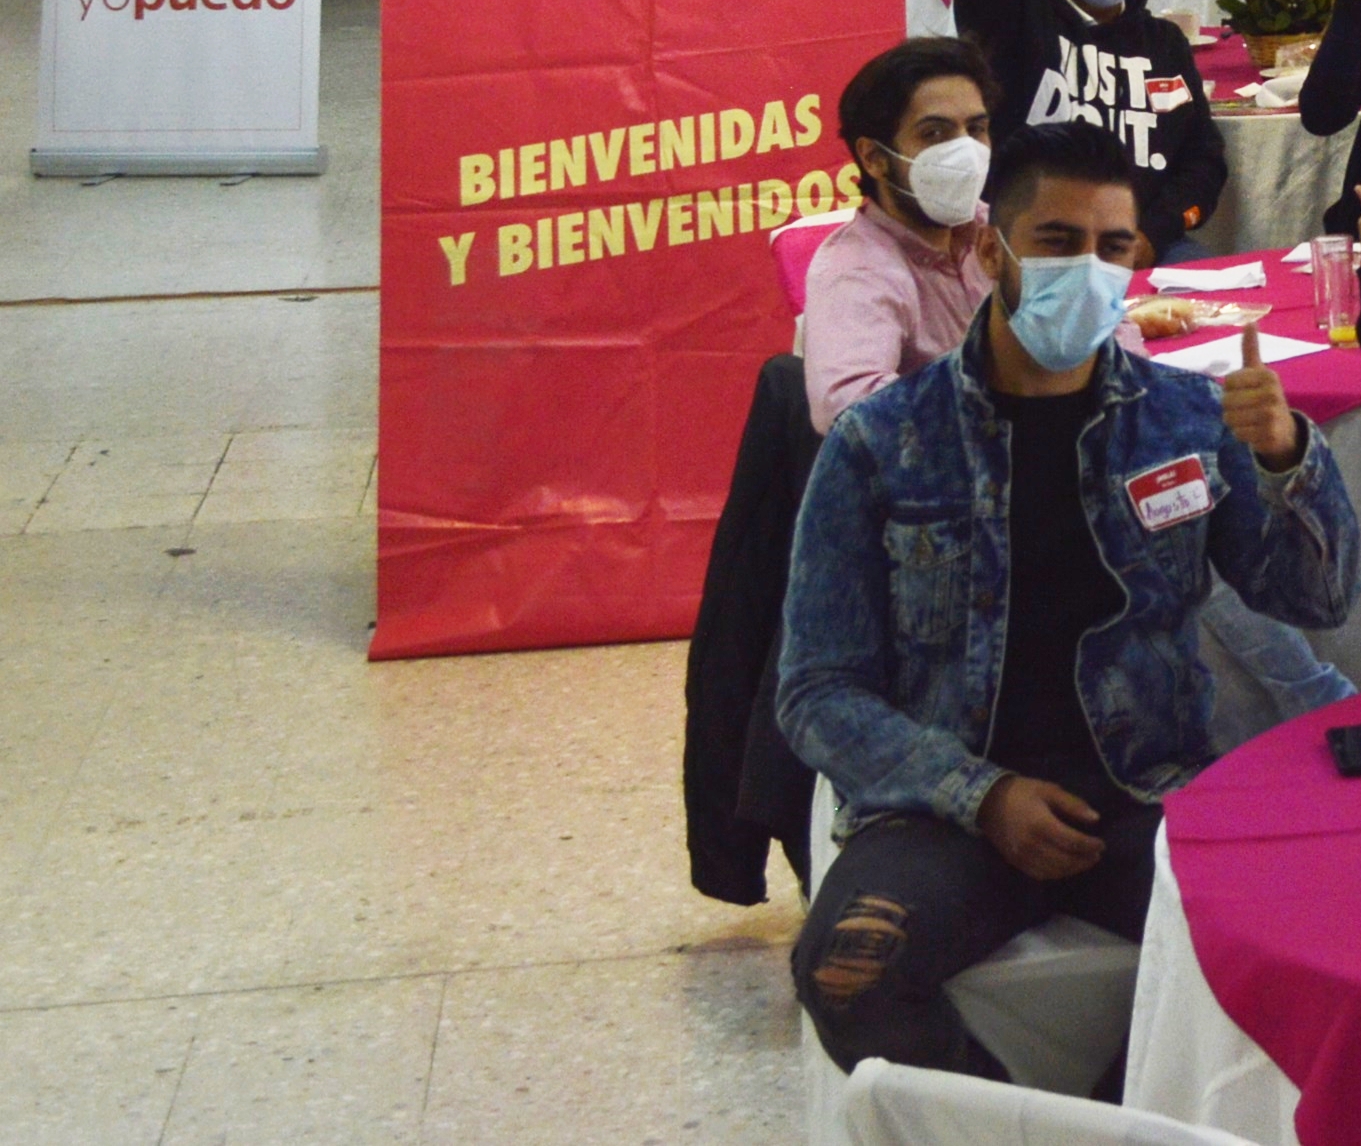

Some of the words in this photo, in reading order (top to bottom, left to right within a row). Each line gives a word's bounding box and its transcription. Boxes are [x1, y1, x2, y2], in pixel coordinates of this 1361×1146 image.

[459, 93, 823, 208] BIENVENIDAS
[437, 231, 476, 287] Y
[498, 162, 864, 278] BIENVENIDOS
